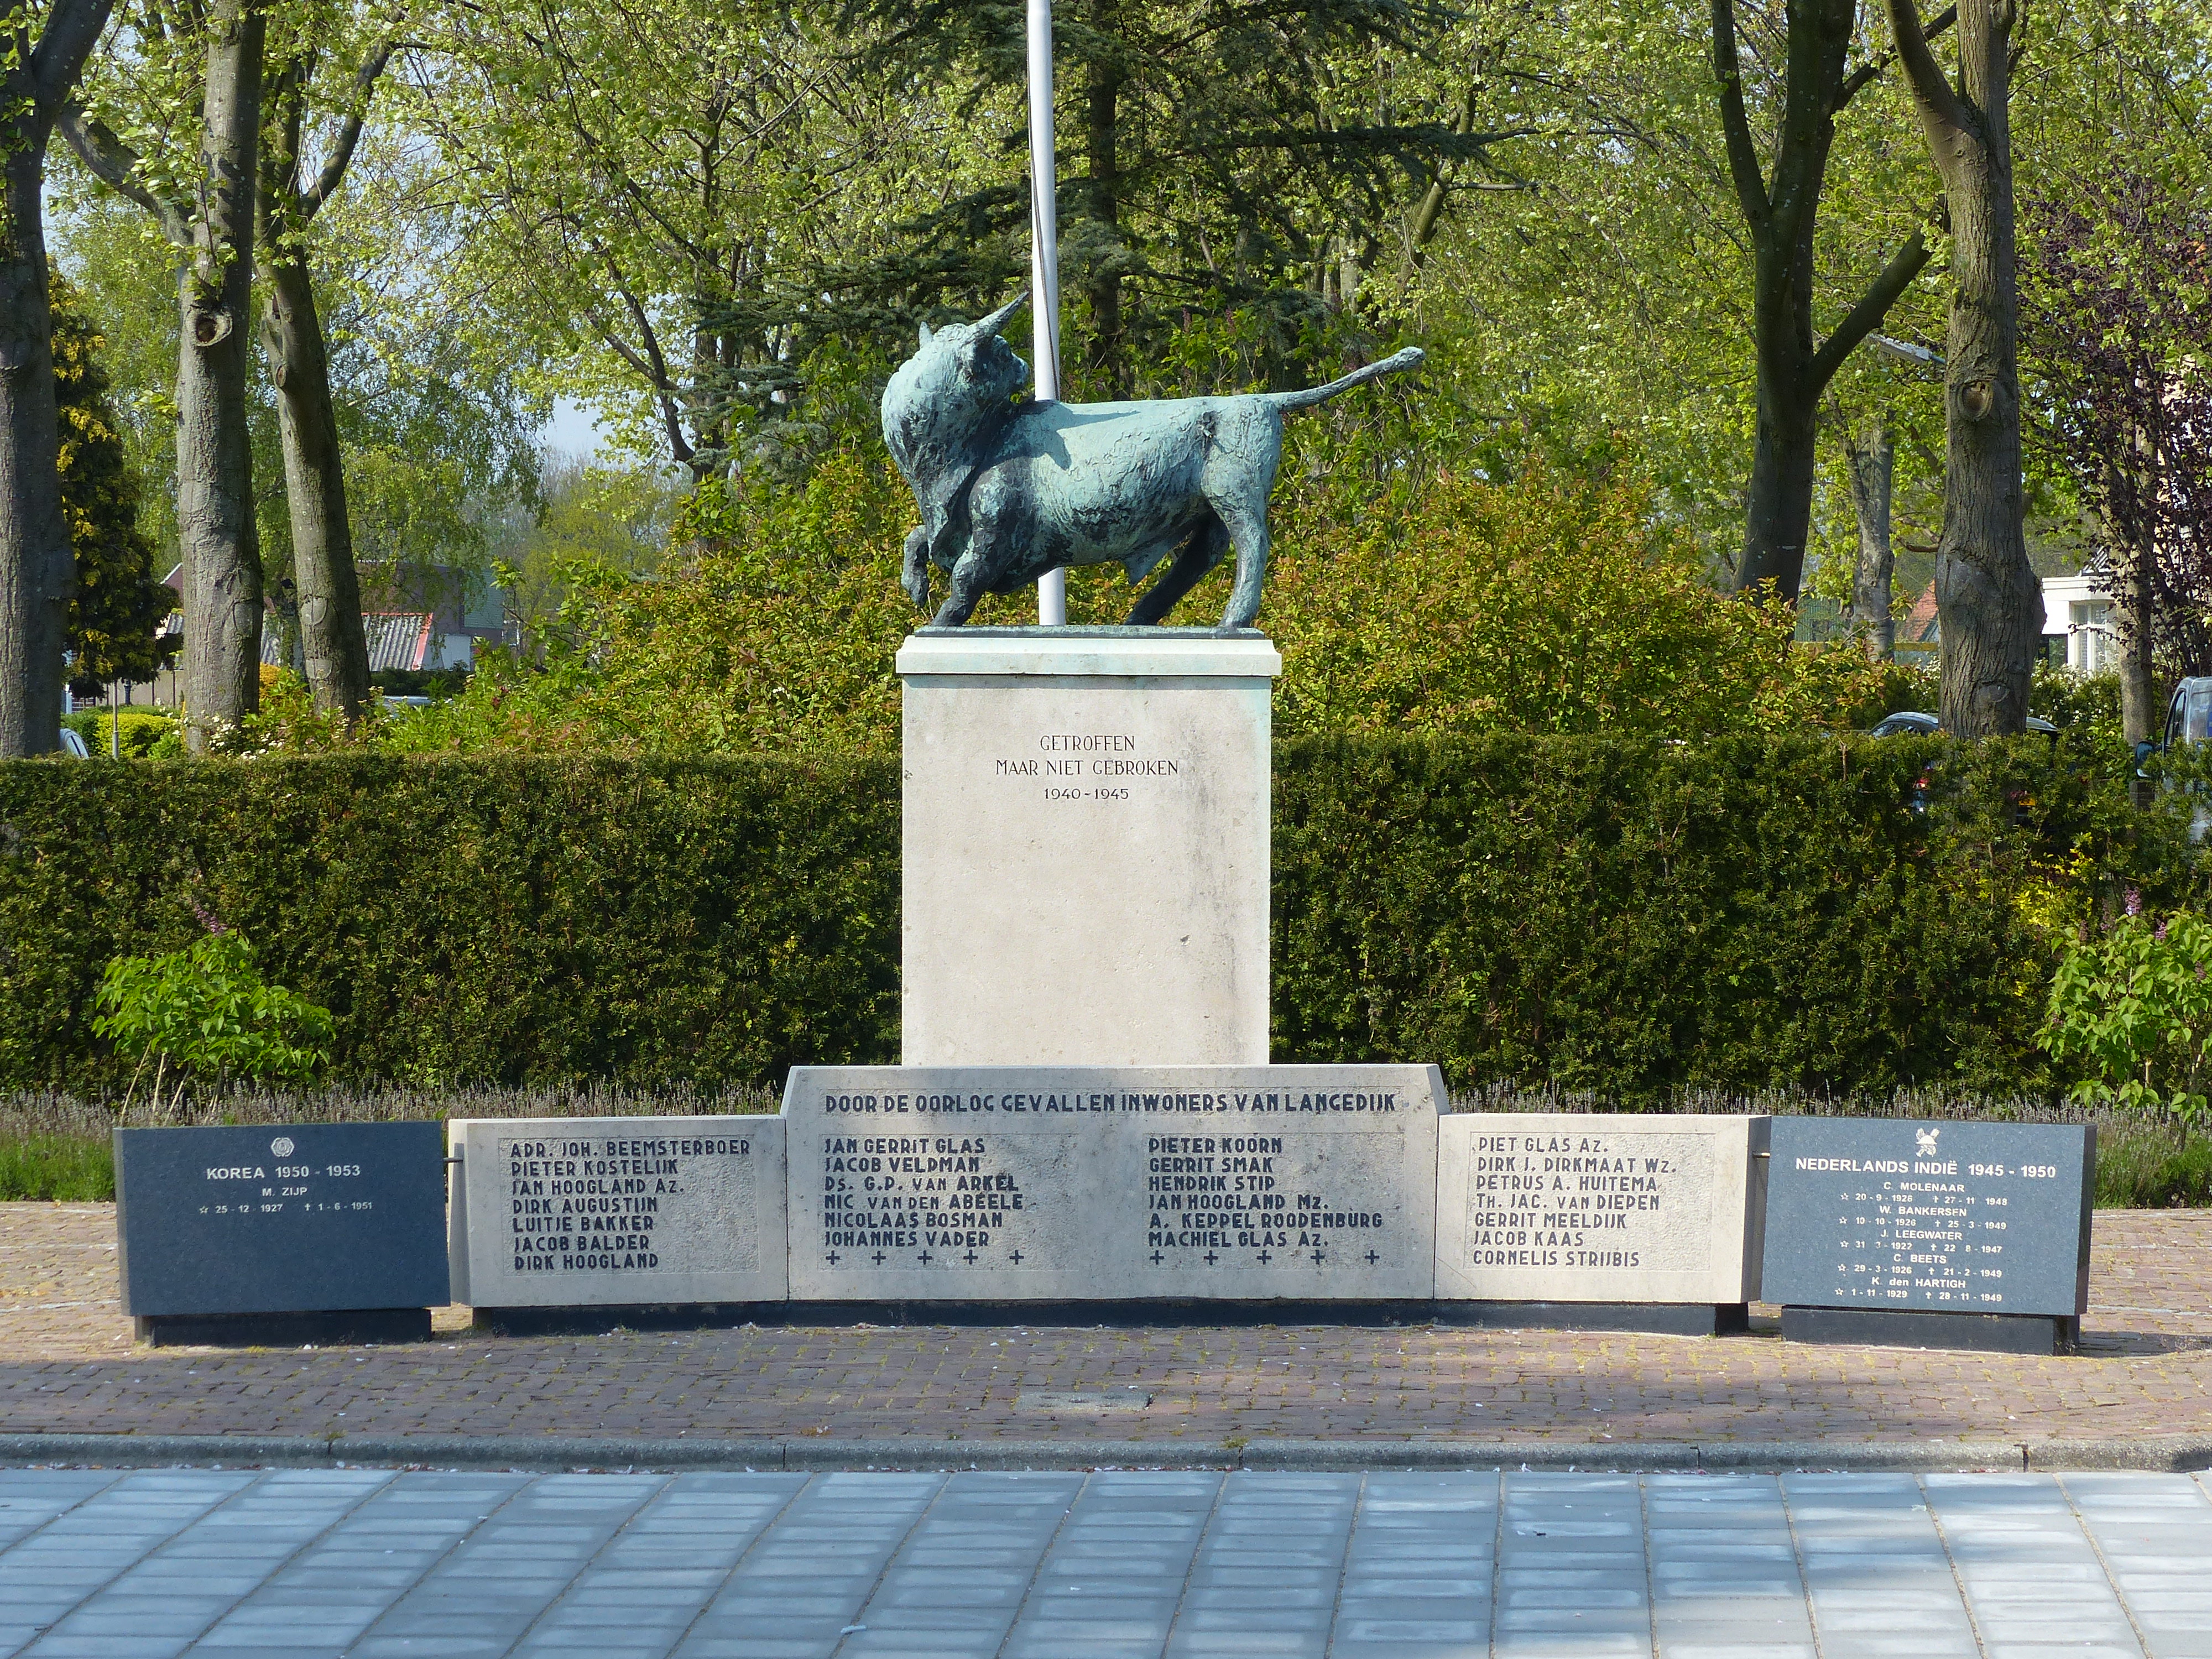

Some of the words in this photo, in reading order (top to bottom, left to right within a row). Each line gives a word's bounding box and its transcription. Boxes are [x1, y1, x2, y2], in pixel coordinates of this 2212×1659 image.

[1040, 735, 1135, 751] GETROFFEN
[995, 760, 1038, 775] MAAR
[1046, 760, 1084, 775] NIET
[1093, 760, 1178, 775] GEBROKEN
[826, 1095, 877, 1113] DOOR
[884, 1095, 909, 1112] DE
[916, 1094, 995, 1112] OORLOG
[1001, 1094, 1115, 1112] GEVALLEN
[1122, 1093, 1227, 1112] INWONERS
[1235, 1093, 1279, 1111] VAN
[1286, 1093, 1395, 1112] LANGEDIJK
[510, 1142, 553, 1157] ADR.
[562, 1142, 598, 1156] JOH.
[607, 1139, 750, 1156] BEEMSTERBOER
[825, 1138, 858, 1154] JAN
[864, 1139, 929, 1154] GERRIT
[936, 1138, 984, 1154] GLAS
[1149, 1138, 1215, 1153] PIETER
[1222, 1138, 1282, 1153] KOORN
[1479, 1137, 1517, 1152] PIET
[1525, 1138, 1570, 1152] GLAS
[512, 1161, 575, 1176] PIETER
[585, 1159, 678, 1175] KOSTELIJK
[825, 1157, 881, 1172] JACOB
[889, 1157, 979, 1172] VELDMAN
[1150, 1157, 1214, 1172] GERRIT
[1222, 1157, 1272, 1172] SMAK
[1478, 1157, 1515, 1171] DIRK
[1524, 1157, 1536, 1171] J.
[1545, 1157, 1635, 1172] DIRKMAAT
[1796, 1157, 1908, 1173] NEDERLANDS
[1914, 1160, 1957, 1175] INDIË
[1968, 1164, 2004, 1177] 1945
[2021, 1165, 2056, 1178] 1950
[206, 1166, 265, 1180] KOREA
[275, 1166, 309, 1178] 1950
[326, 1165, 361, 1177] 1953
[513, 1180, 542, 1195] JAN
[552, 1178, 646, 1194] HOOGLAND
[912, 1178, 946, 1191] VAN
[957, 1176, 1019, 1191] ARKEL
[1149, 1176, 1227, 1191] HENDRIK
[1235, 1176, 1275, 1191] STIP
[1477, 1176, 1543, 1190] PETRUS
[1552, 1176, 1571, 1191] A.
[1579, 1177, 1657, 1192] HUITEMA
[1901, 1182, 1964, 1192] MOLENAAR
[282, 1187, 307, 1196] ZIJP
[215, 1205, 228, 1213] 25
[238, 1204, 249, 1213] 12
[260, 1204, 283, 1212] 1927
[351, 1202, 372, 1210] 1951
[513, 1199, 552, 1214] DIRK
[562, 1197, 657, 1213] AUGUSTIJN
[825, 1194, 853, 1209] NIC
[867, 1197, 901, 1209] VAN
[909, 1197, 938, 1209] DEN
[950, 1194, 1023, 1209] ABEELE
[1149, 1194, 1181, 1209] JAN
[1188, 1194, 1285, 1209] HOOGLAND
[1510, 1194, 1547, 1209] JAC.
[1557, 1196, 1589, 1209] VAN
[1597, 1195, 1660, 1210] DIEPEN
[1899, 1207, 1966, 1217] BANKERSEN
[513, 1217, 572, 1233] LUITJE
[581, 1215, 653, 1231] BAKKER
[825, 1212, 919, 1228] NICOLAAS
[926, 1212, 1002, 1228] BOSMAN
[1150, 1213, 1168, 1229] A.
[1182, 1213, 1255, 1228] KEPPEL
[1261, 1213, 1382, 1228] ROODENBURG
[1475, 1212, 1536, 1227] GERRIT
[1544, 1213, 1626, 1229] MEELDIJK
[825, 1232, 917, 1246] JOHANNES
[926, 1231, 988, 1246] VADER
[1149, 1232, 1231, 1246] MACHIEL
[1238, 1232, 1286, 1246] GLAS
[1475, 1231, 1526, 1245] JACOB
[1535, 1232, 1583, 1246] KAAS
[1896, 1230, 1962, 1240] LEEGWATER
[515, 1237, 569, 1253] JACOB
[577, 1235, 649, 1250] BALDER
[515, 1255, 555, 1270] DIRK
[564, 1253, 658, 1270] HOOGLAND
[1474, 1250, 1557, 1265] CORNELIS
[1566, 1251, 1640, 1267] STRIJBIS
[1911, 1255, 1947, 1264] BEETS
[1916, 1279, 1966, 1288] HARTIGH
